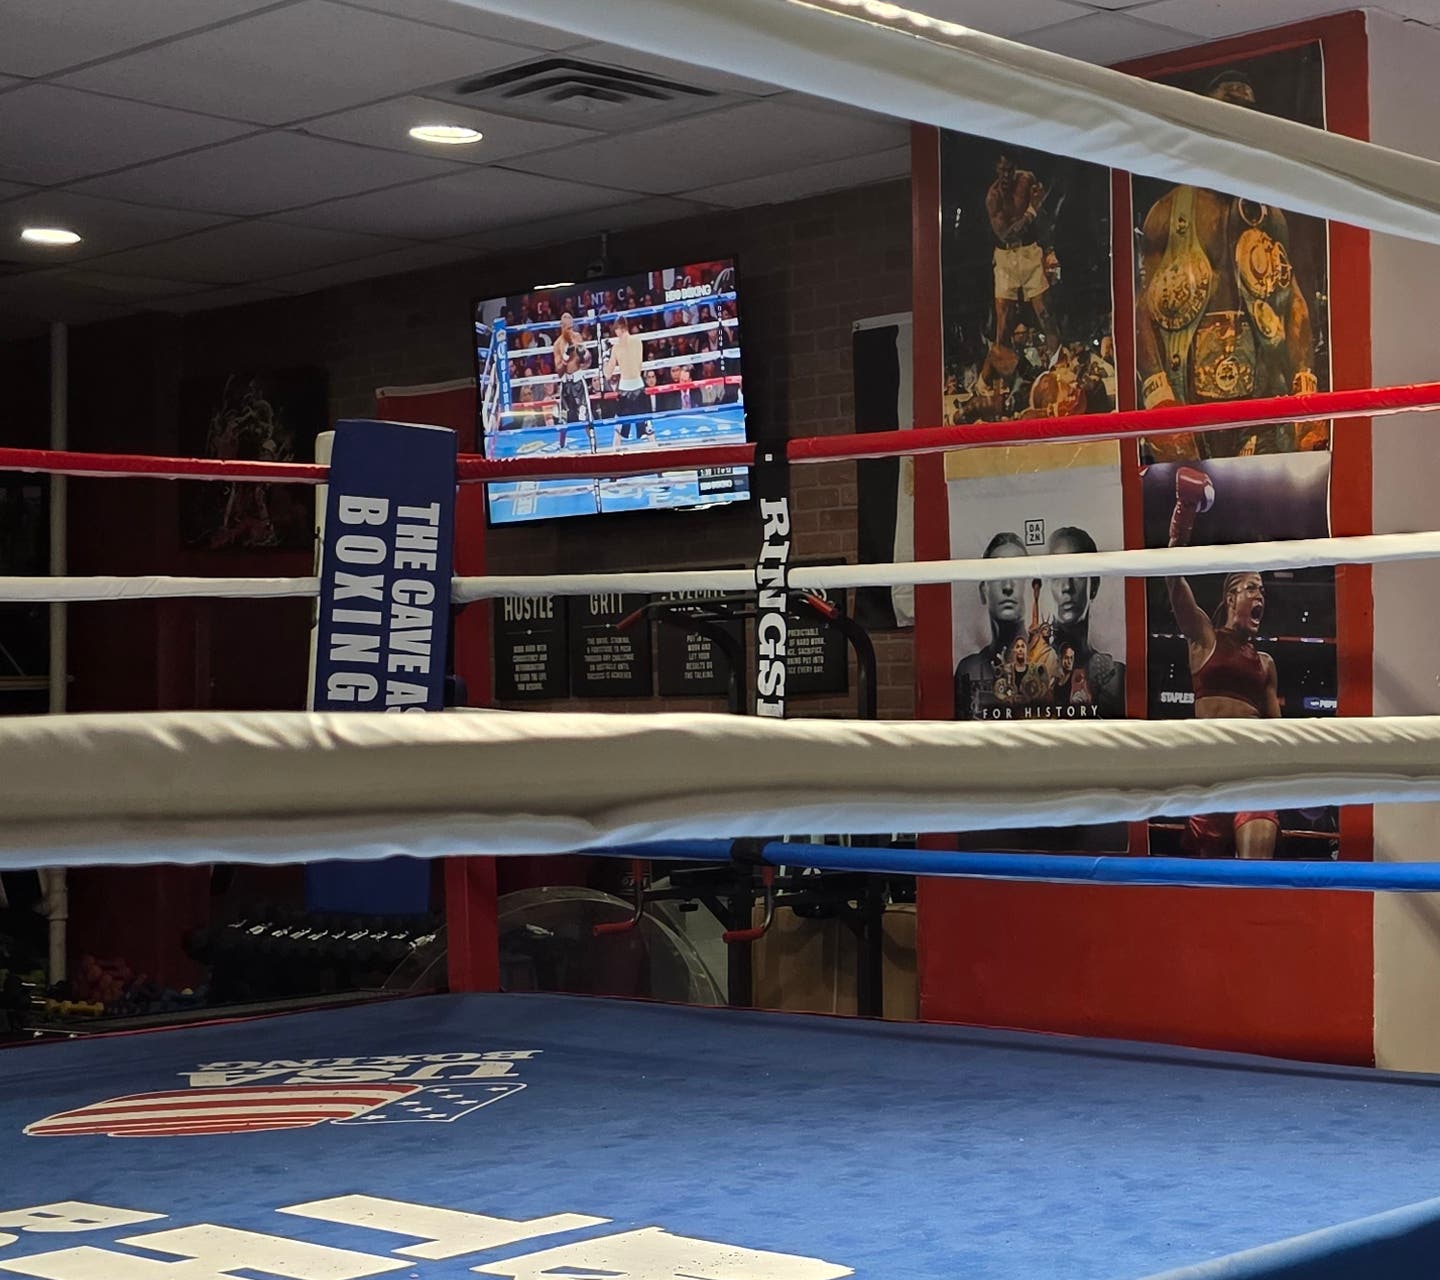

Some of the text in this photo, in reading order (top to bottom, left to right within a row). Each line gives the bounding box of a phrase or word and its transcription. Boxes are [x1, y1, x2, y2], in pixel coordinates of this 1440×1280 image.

[393, 502, 441, 571] THE
[327, 495, 389, 702] BOXING
[503, 595, 554, 621] HUSTLE
[756, 498, 791, 718] RINGSI
[387, 578, 436, 673] CAVE
[982, 704, 1100, 719] FOR HISTORY
[1160, 692, 1195, 704] STAPLES
[197, 1049, 544, 1071] BOXING
[177, 1061, 521, 1088] USA
